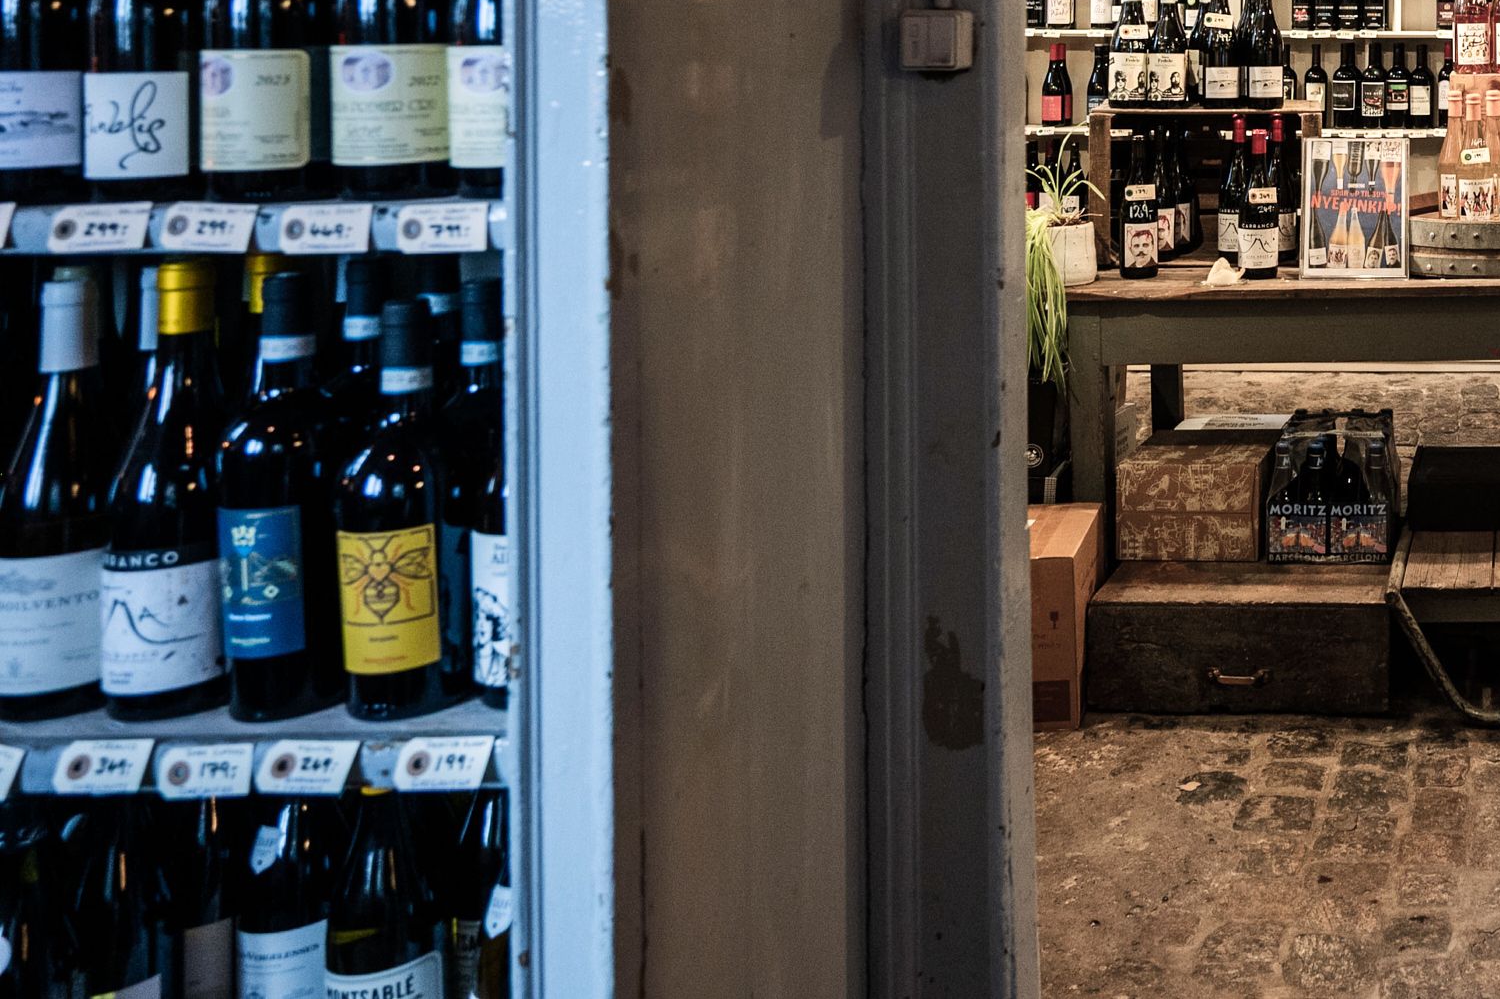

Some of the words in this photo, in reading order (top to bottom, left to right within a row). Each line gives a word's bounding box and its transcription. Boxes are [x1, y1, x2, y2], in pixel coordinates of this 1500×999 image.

[1311, 194, 1339, 209] NYE
[1241, 221, 1274, 229] CARRANCO
[1269, 503, 1327, 517] MORITZ
[1330, 503, 1387, 517] MORITZ
